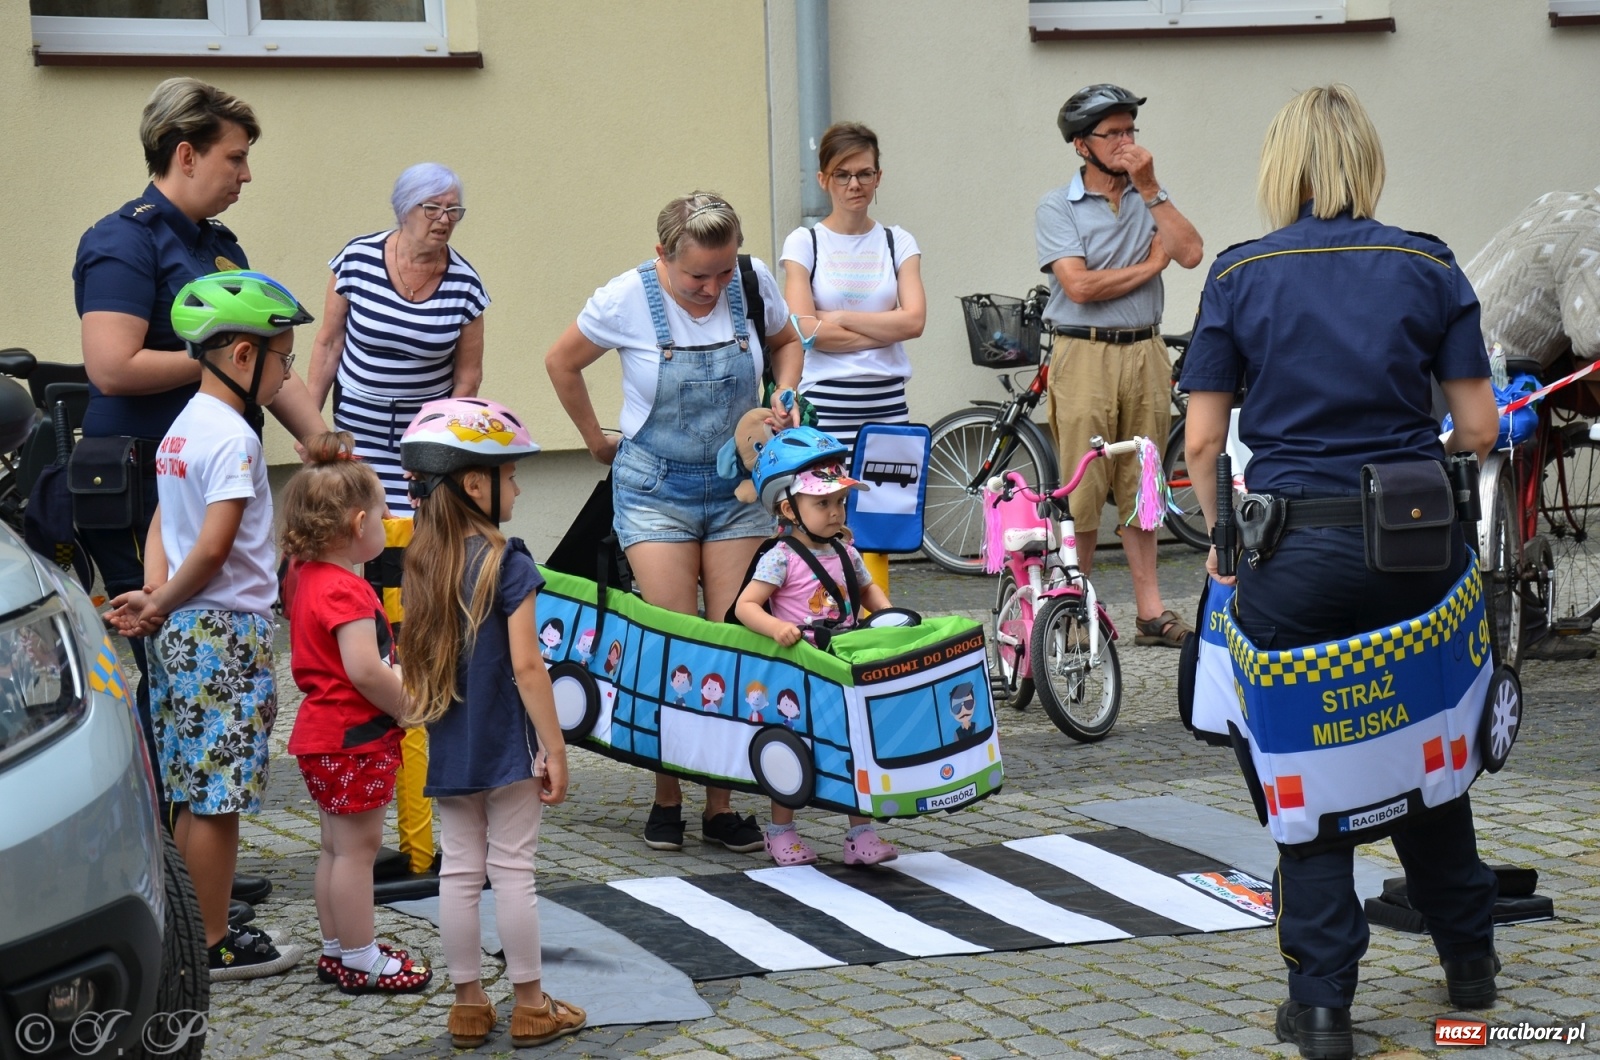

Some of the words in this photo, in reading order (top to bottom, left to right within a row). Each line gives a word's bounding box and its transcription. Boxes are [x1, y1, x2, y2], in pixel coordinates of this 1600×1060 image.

[861, 659, 919, 682] GOTOWI
[923, 651, 941, 667] DO
[945, 634, 984, 658] DROGI
[1321, 669, 1396, 713] STRAŻ
[1312, 703, 1410, 746] MIEJSKA
[930, 785, 975, 808] RACIBÓRZ
[1351, 803, 1407, 829] RACIBÓRZ
